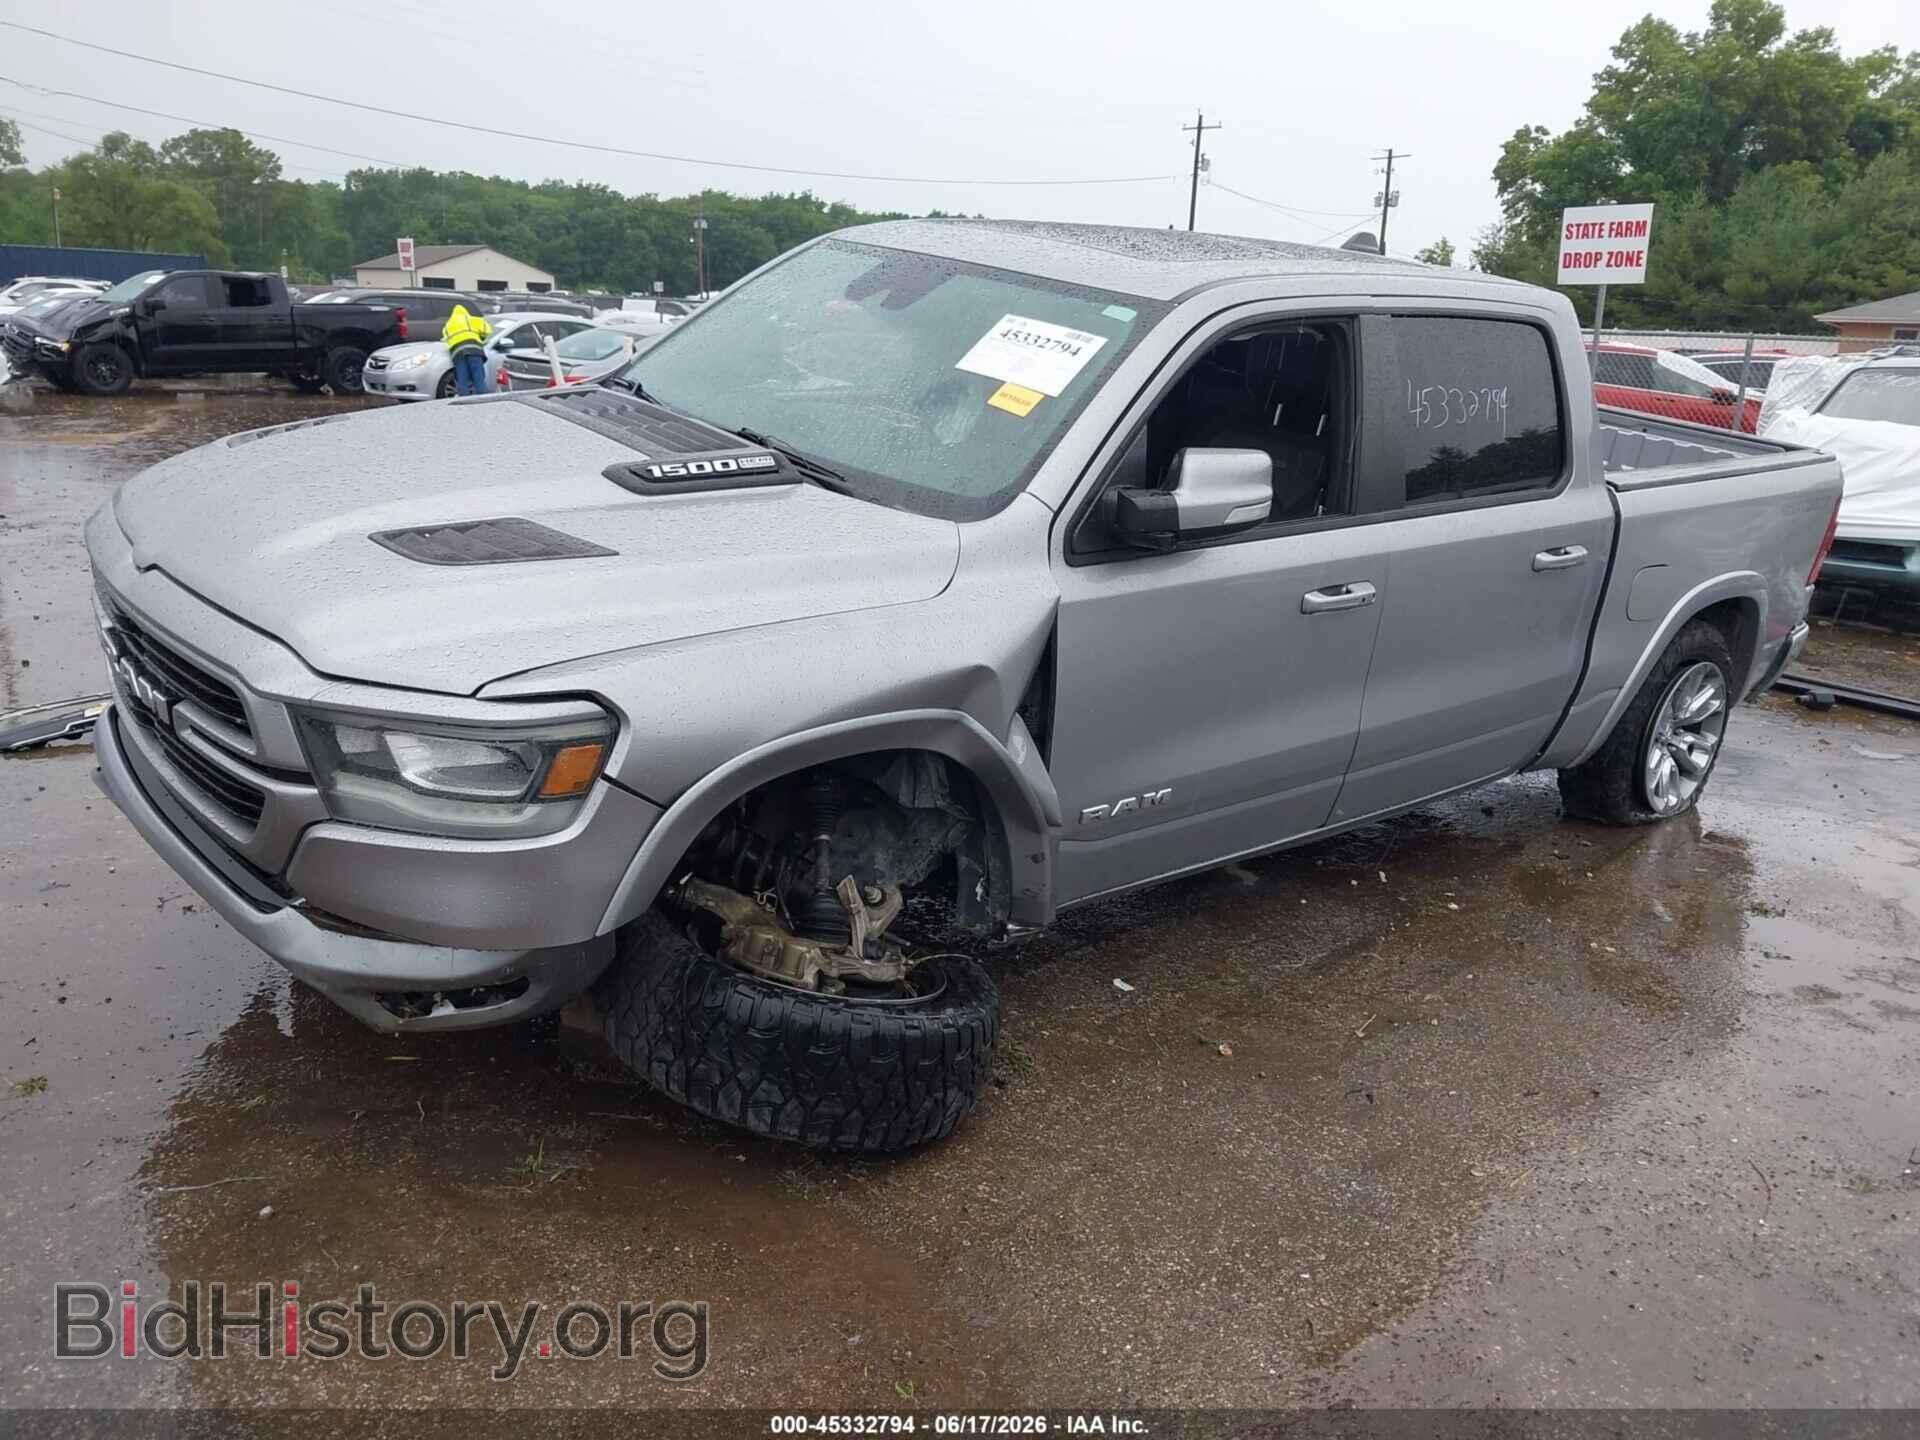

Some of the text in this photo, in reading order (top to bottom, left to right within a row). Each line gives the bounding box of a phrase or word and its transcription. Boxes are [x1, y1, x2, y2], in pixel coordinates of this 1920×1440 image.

[1565, 220, 1648, 240] STATE FARM
[1562, 250, 1644, 269] DROP ZONE
[1000, 328, 1082, 357] 45332794
[1407, 378, 1509, 439] 45332794
[647, 459, 738, 478] 1500
[1079, 788, 1172, 824] RAM
